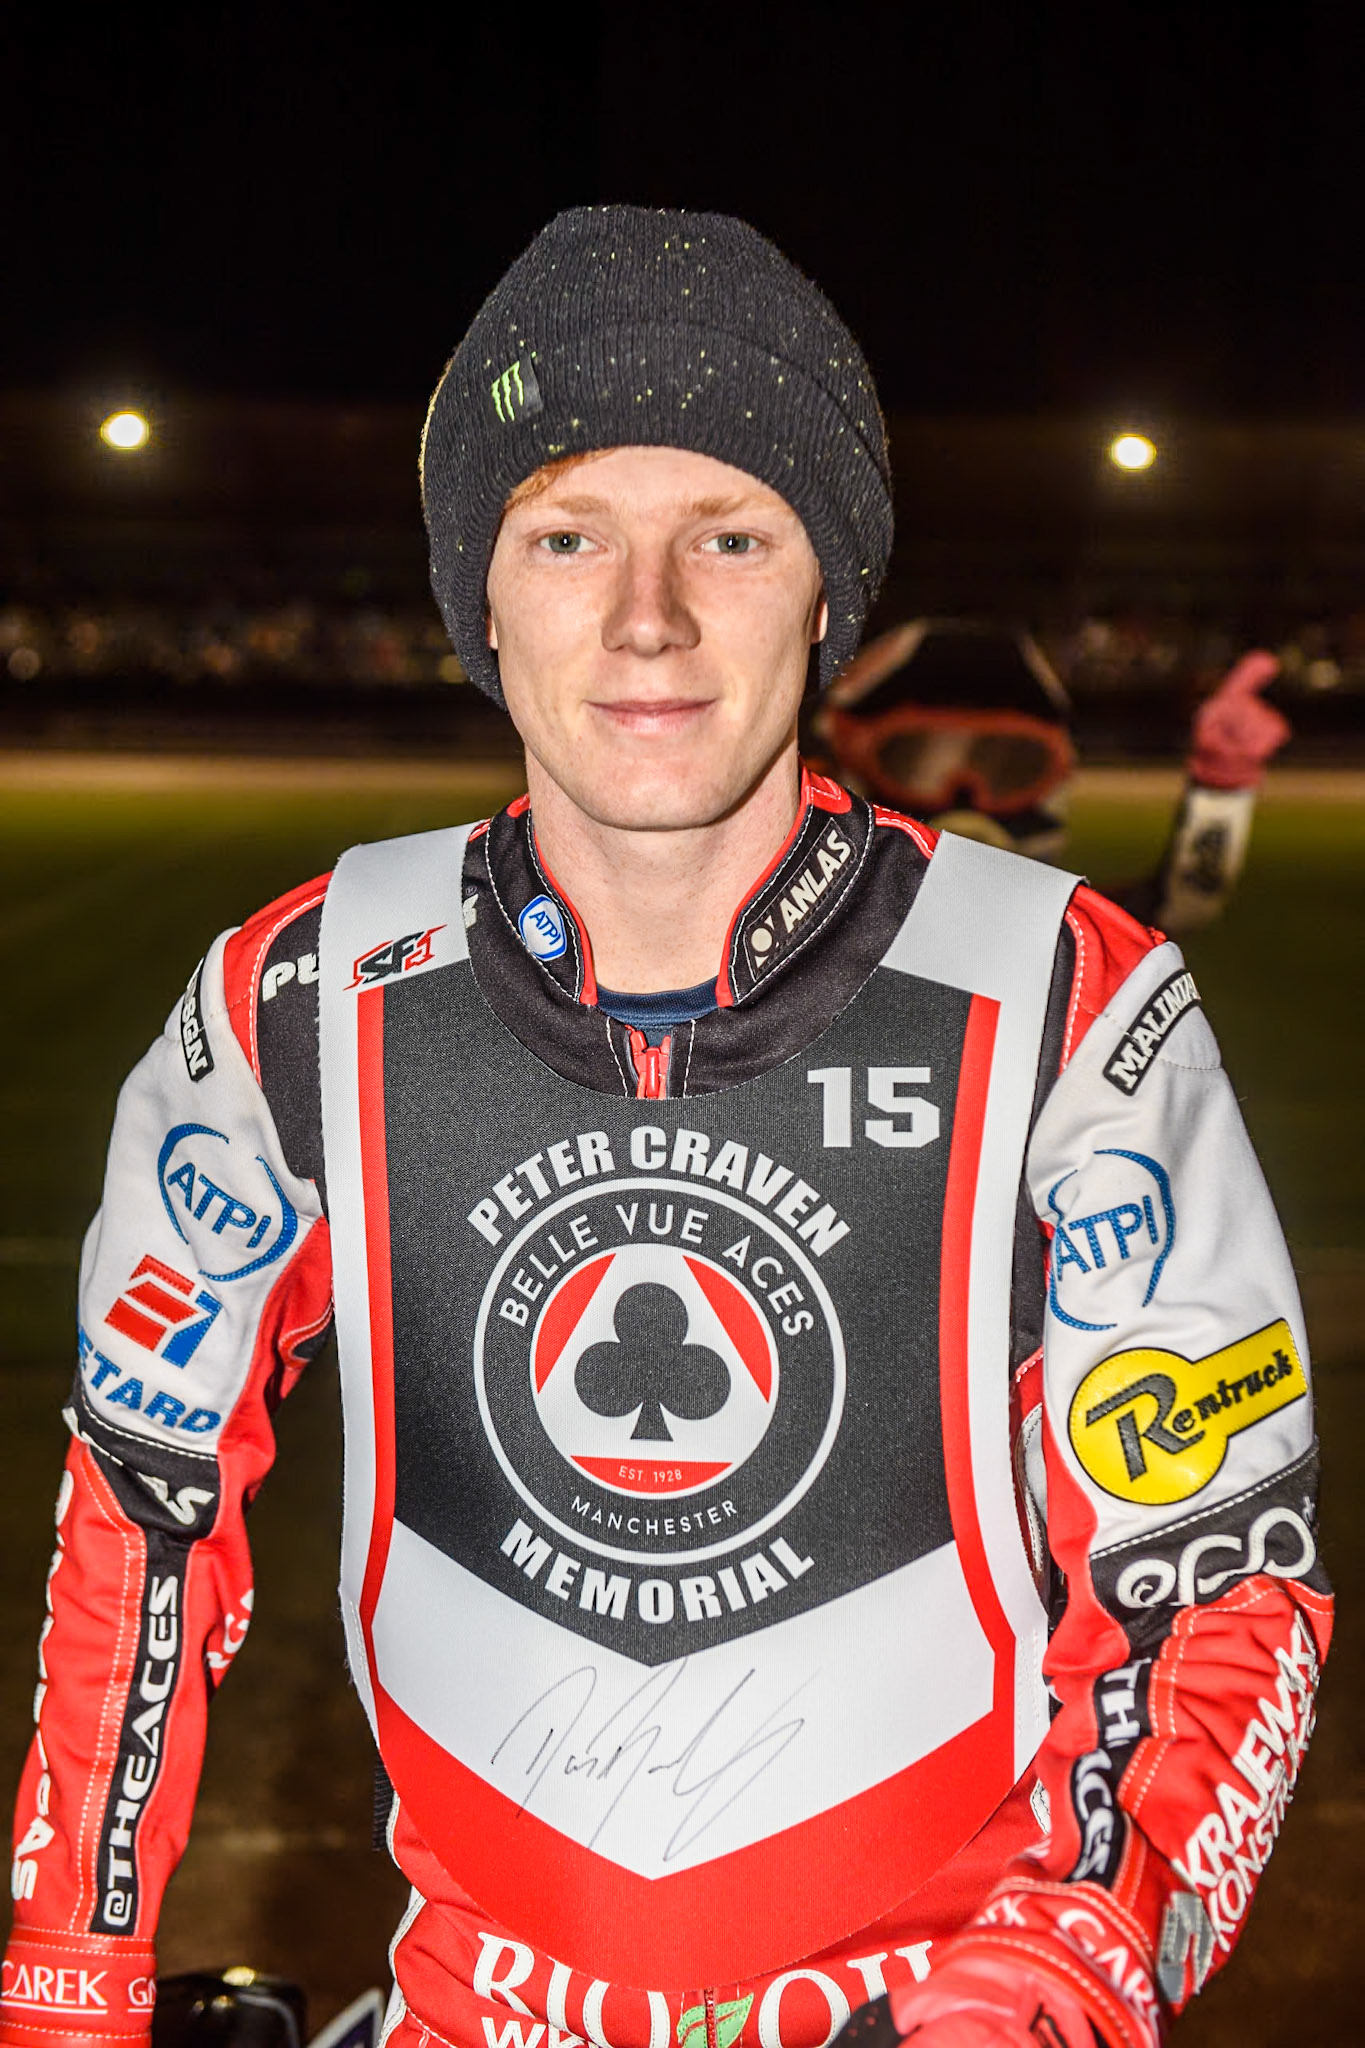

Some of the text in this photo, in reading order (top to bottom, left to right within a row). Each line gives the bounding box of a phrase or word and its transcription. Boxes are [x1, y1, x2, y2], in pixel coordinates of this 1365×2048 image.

[781, 828, 852, 934] ANLAS
[528, 910, 562, 946] ATPI
[807, 1066, 940, 1148] 15
[166, 1161, 273, 1249] ATPI
[467, 1126, 852, 1257] PETER CRAVEN
[499, 1202, 815, 1337] BELLE VUE ACES
[1056, 1194, 1160, 1282] ATPI
[1084, 1349, 1294, 1483] Rentruck
[571, 1494, 738, 1536] MANCHESTER
[618, 1465, 683, 1483] EST. 1928
[499, 1517, 816, 1624] MEMORIAL
